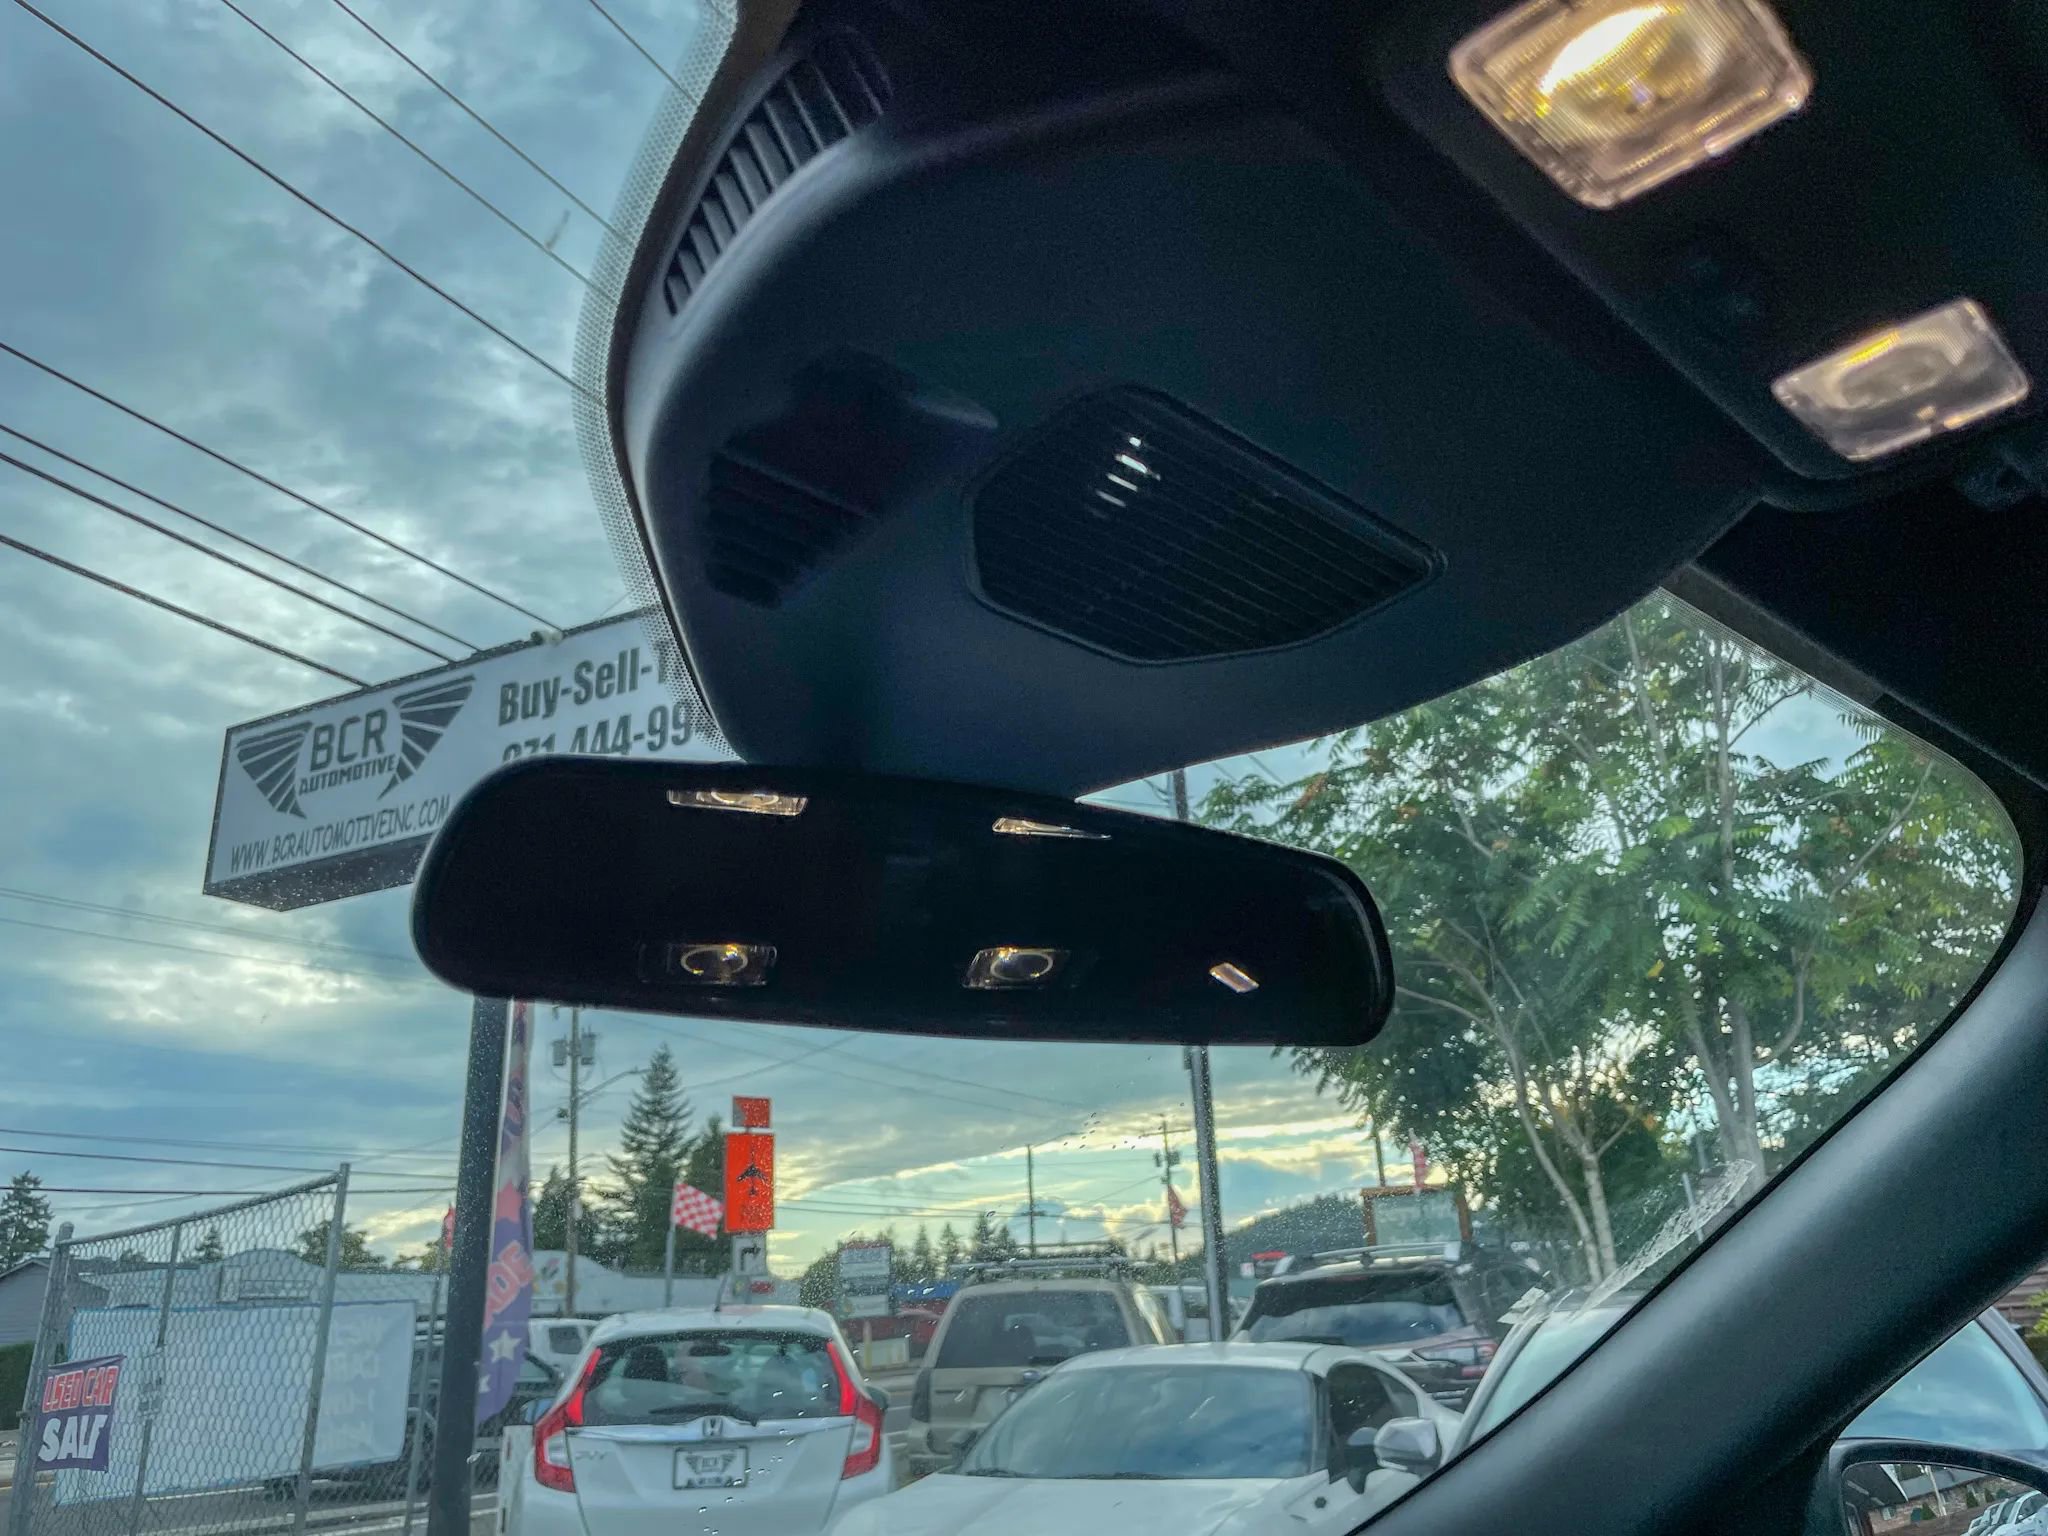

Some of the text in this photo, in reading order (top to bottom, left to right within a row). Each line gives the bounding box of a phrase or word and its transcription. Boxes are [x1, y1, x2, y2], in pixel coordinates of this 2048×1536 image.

[310, 708, 388, 773] BCR
[299, 754, 396, 796] AUTOMOTIVE
[230, 794, 450, 873] WWW.BCRAUTOMOTIVEINC.COM
[42, 1365, 119, 1413] USED CAR
